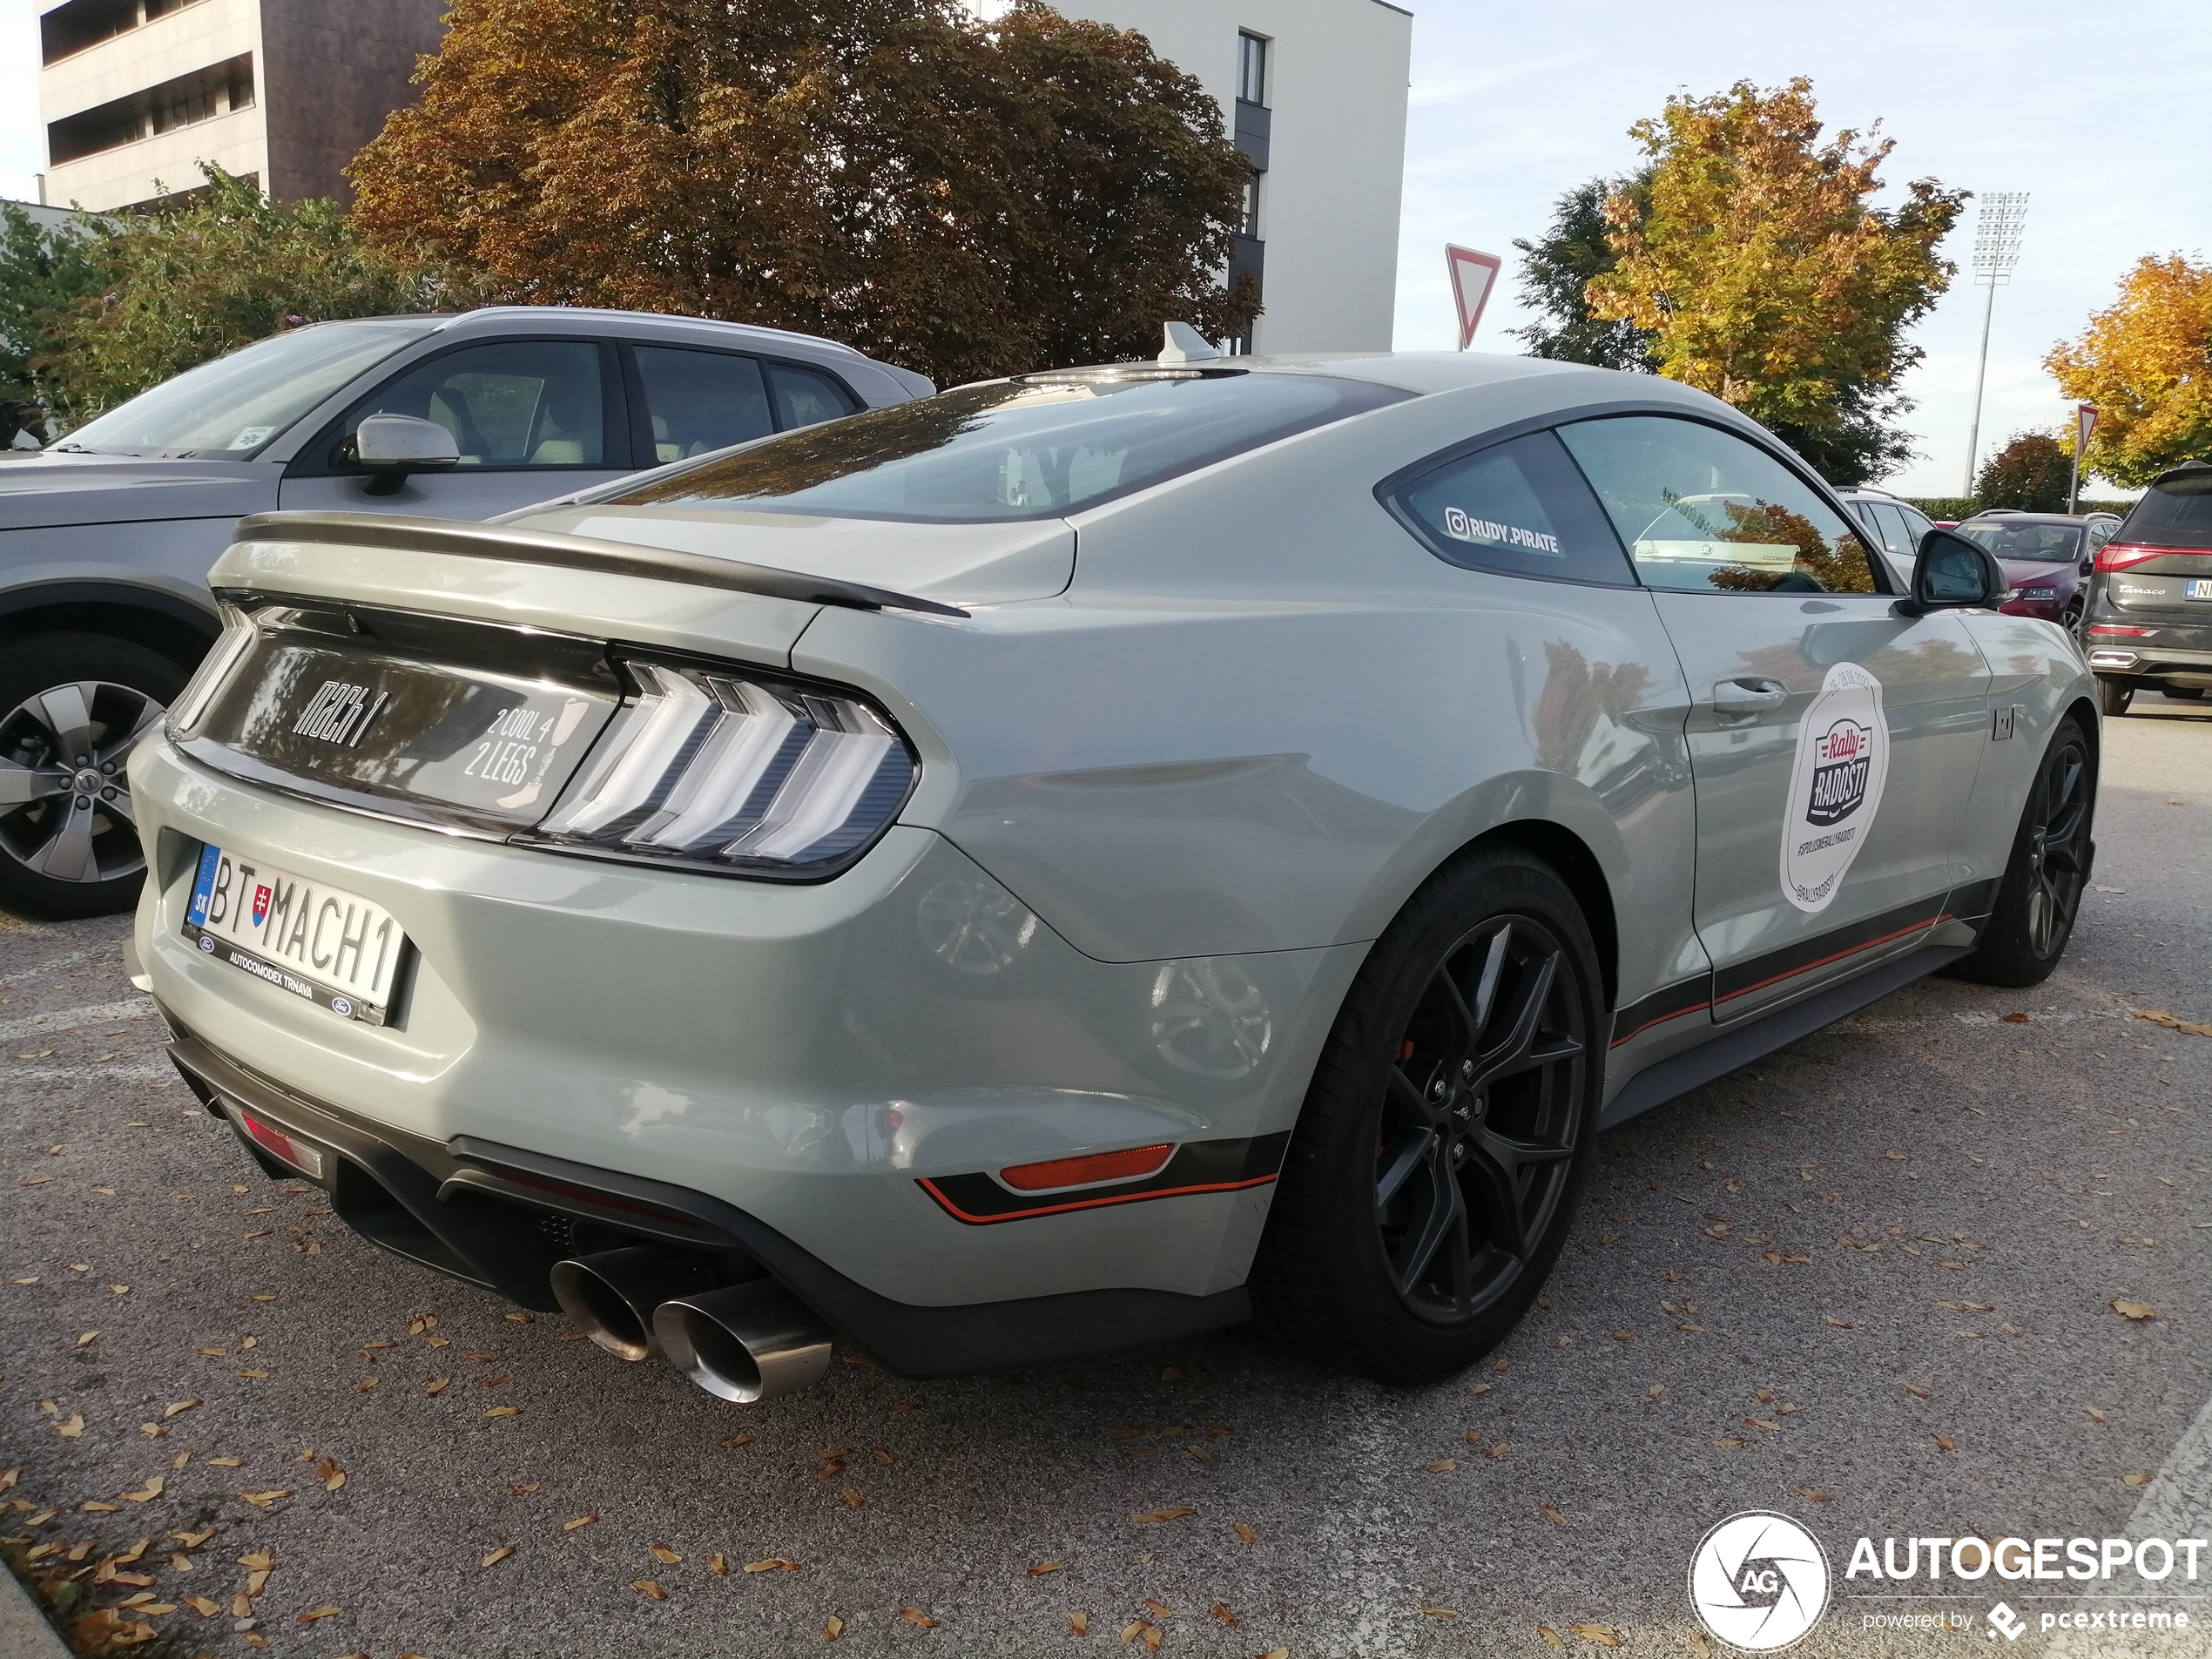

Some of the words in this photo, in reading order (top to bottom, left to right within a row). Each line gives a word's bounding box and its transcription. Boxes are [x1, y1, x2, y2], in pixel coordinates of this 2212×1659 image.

[1469, 517, 1559, 554] RUDY.PIRATE
[2118, 584, 2167, 595] Tarraco
[349, 691, 391, 749] 1
[487, 708, 508, 734] 2
[499, 707, 540, 741] COOL
[538, 717, 556, 743] 4
[464, 741, 490, 778] 2
[480, 742, 538, 786] LEGS
[1828, 728, 1860, 762] Rally
[1813, 761, 1867, 806] RADOSTI
[194, 893, 209, 914] SK
[208, 856, 257, 934] BT
[261, 875, 395, 994] MACH1
[229, 951, 283, 986] AUTOCOMODEX
[283, 974, 314, 1000] TRNAVA
